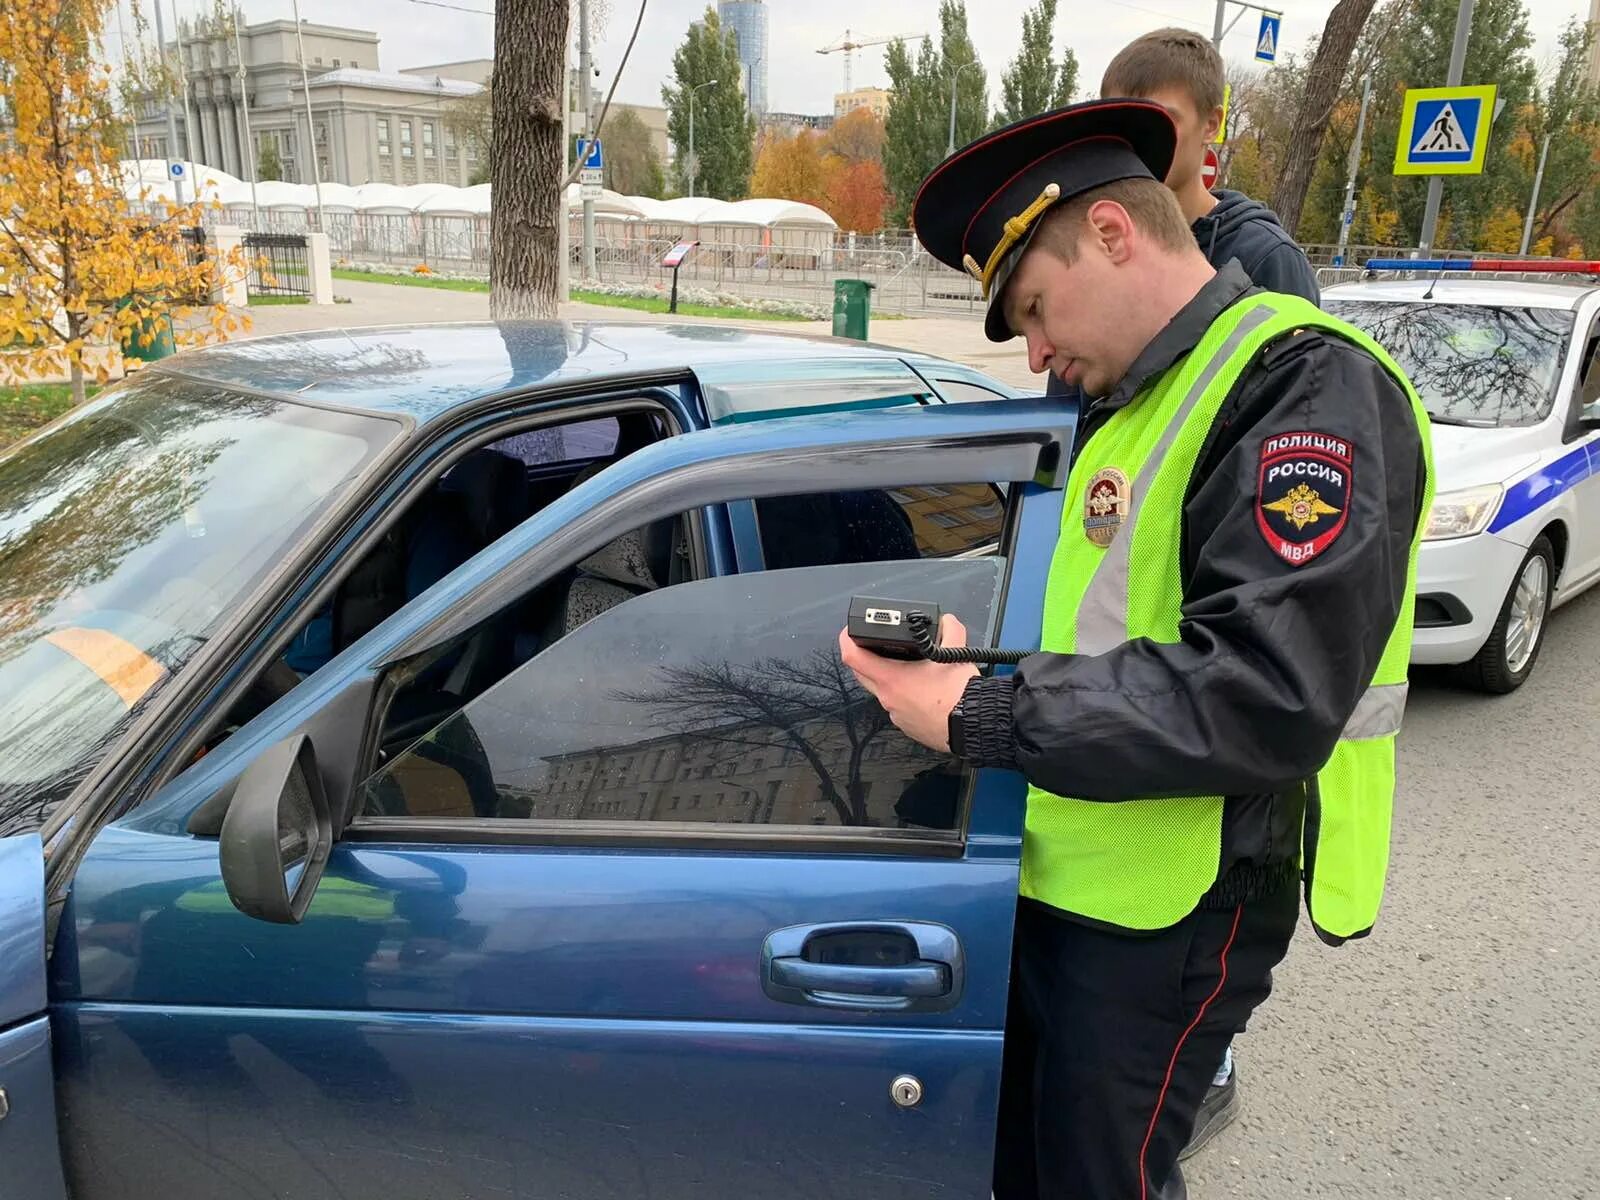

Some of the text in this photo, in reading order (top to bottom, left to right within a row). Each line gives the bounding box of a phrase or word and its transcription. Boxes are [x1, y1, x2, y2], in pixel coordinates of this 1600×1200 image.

[1267, 435, 1347, 457] ПОЛИЦИЯ
[1268, 462, 1343, 487] РОССИЯ
[1280, 542, 1314, 560] МВД
